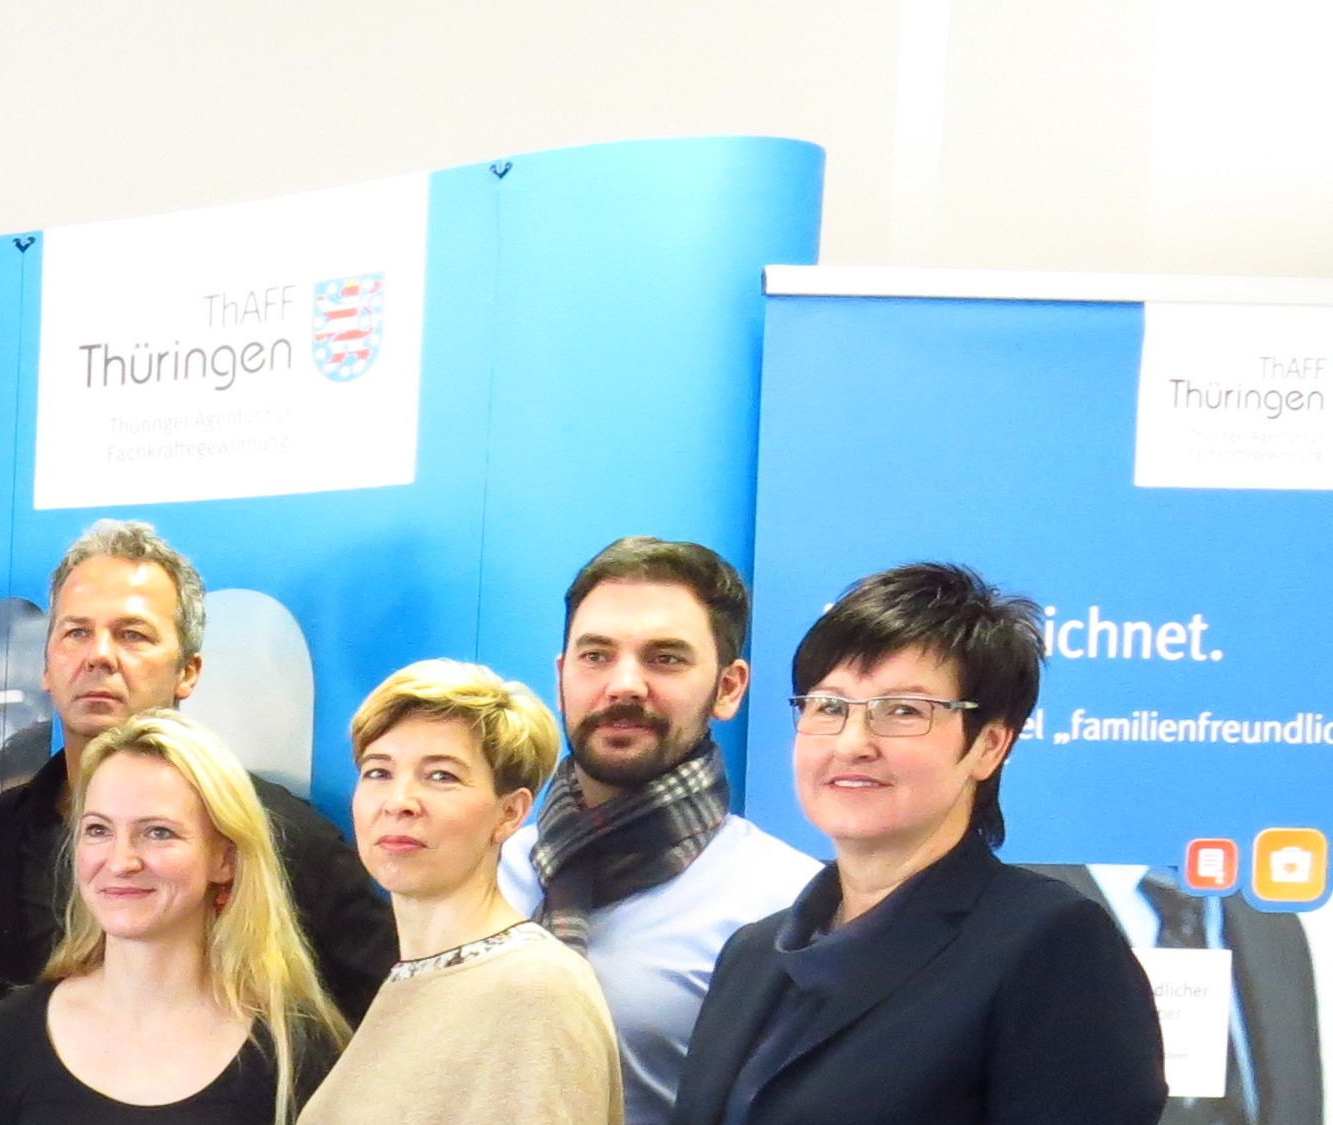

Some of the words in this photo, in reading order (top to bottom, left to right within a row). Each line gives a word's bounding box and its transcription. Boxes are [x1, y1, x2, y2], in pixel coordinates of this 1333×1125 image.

[203, 284, 297, 328] ThAFF
[79, 338, 292, 391] Thüringen
[1259, 357, 1327, 379] ThAFF
[1170, 379, 1325, 421] Thüringen
[1044, 606, 1223, 661] ichnet.
[1053, 708, 1333, 745] „familienfreundlic
